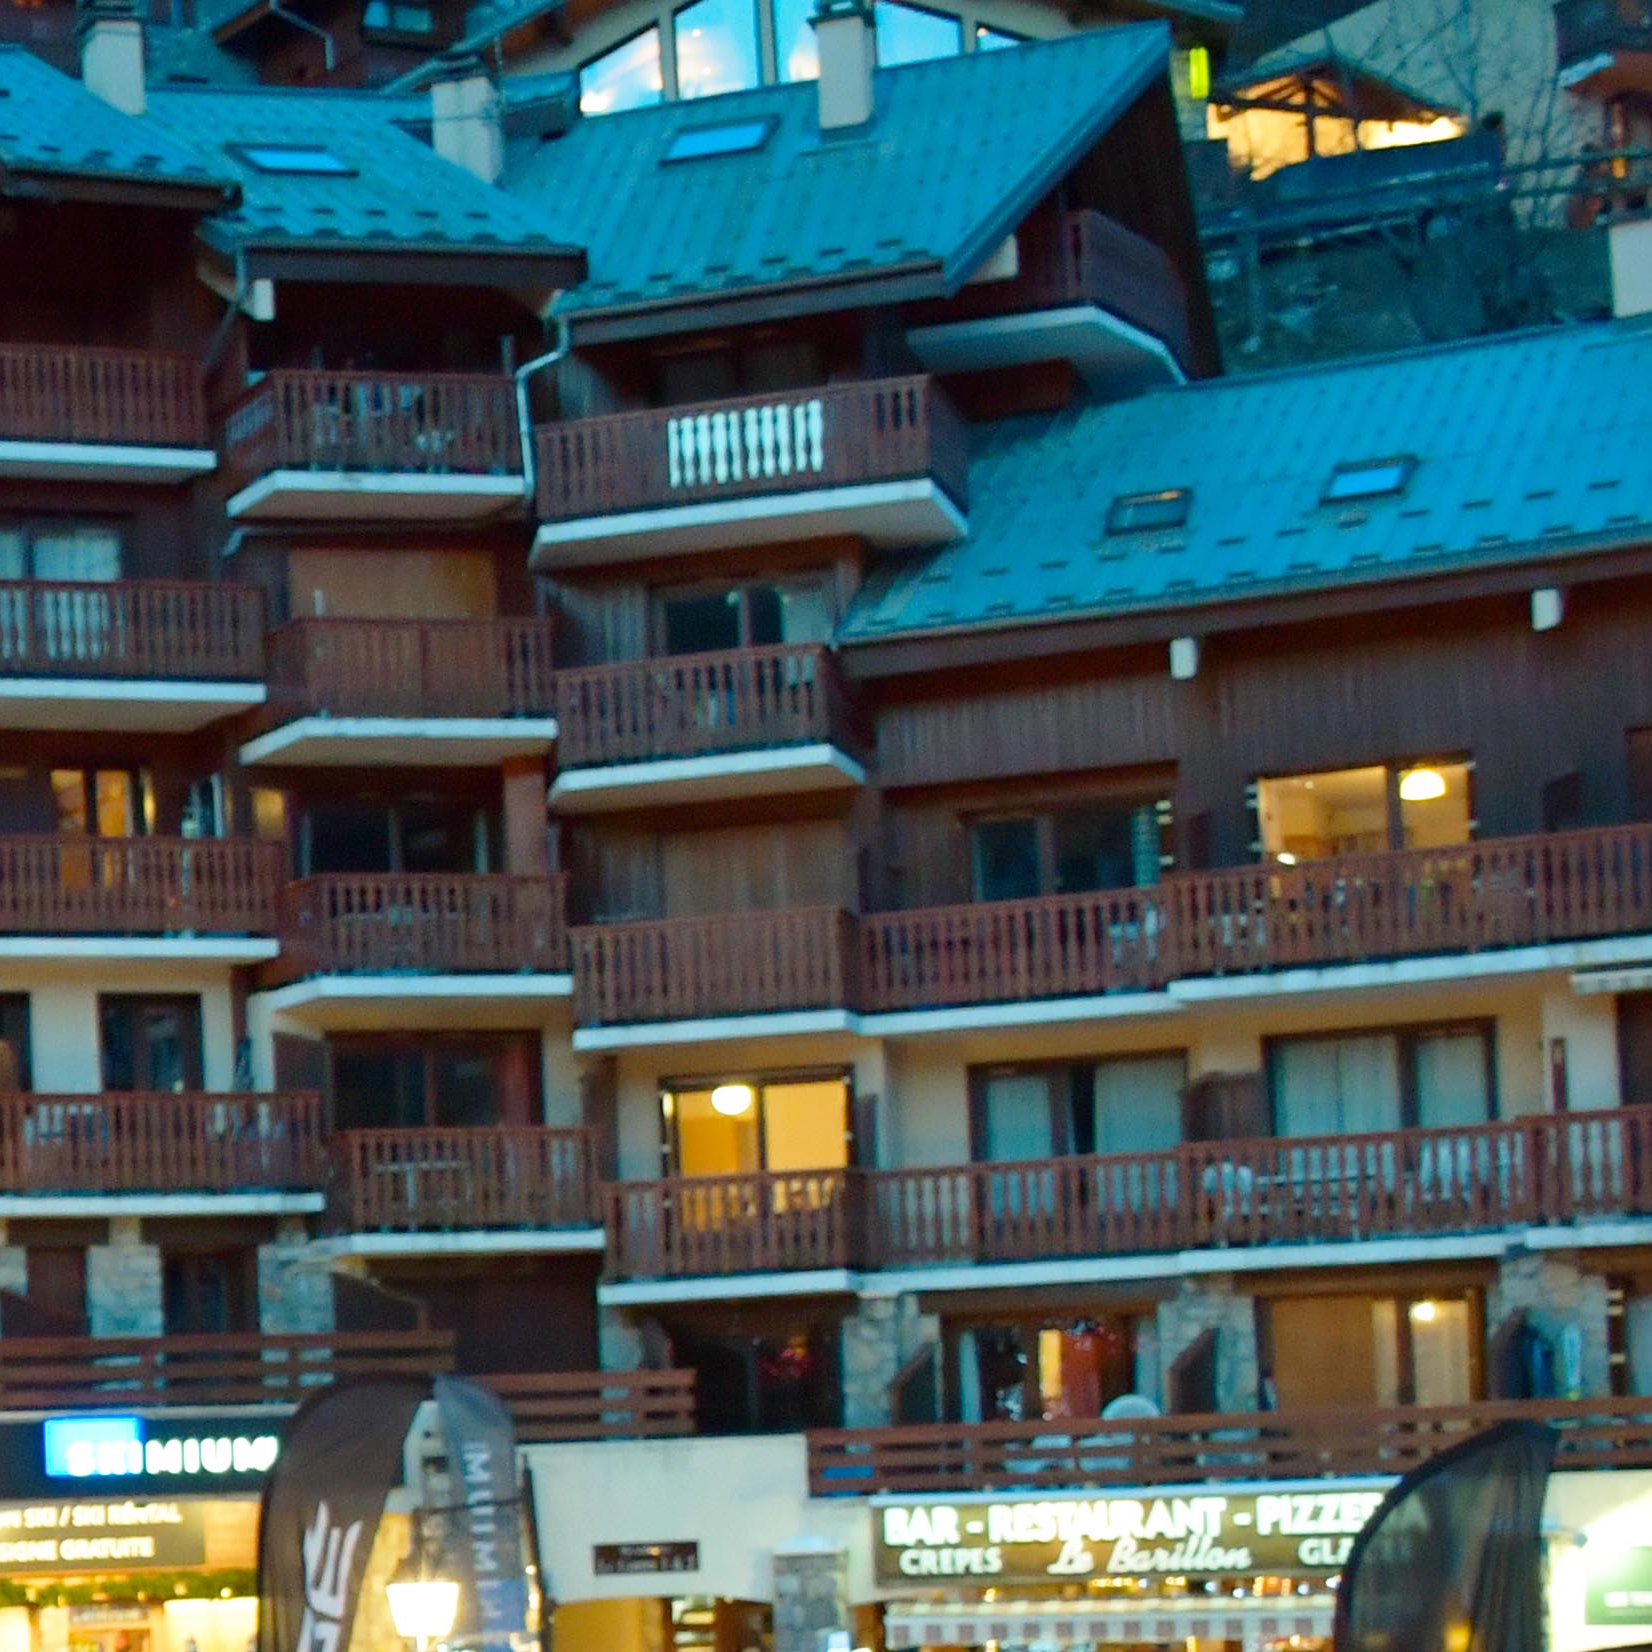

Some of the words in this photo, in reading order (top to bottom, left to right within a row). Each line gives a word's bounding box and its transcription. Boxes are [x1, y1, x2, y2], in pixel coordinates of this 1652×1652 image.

[66, 1435, 279, 1477] SKIMIUM
[24, 1507, 57, 1529] SKI
[73, 1504, 106, 1528] SKI
[883, 1506, 961, 1546] BAR
[988, 1497, 1227, 1543] RESTAURANT
[60, 1536, 155, 1563] GRATUITE
[1046, 1533, 1094, 1575] Le
